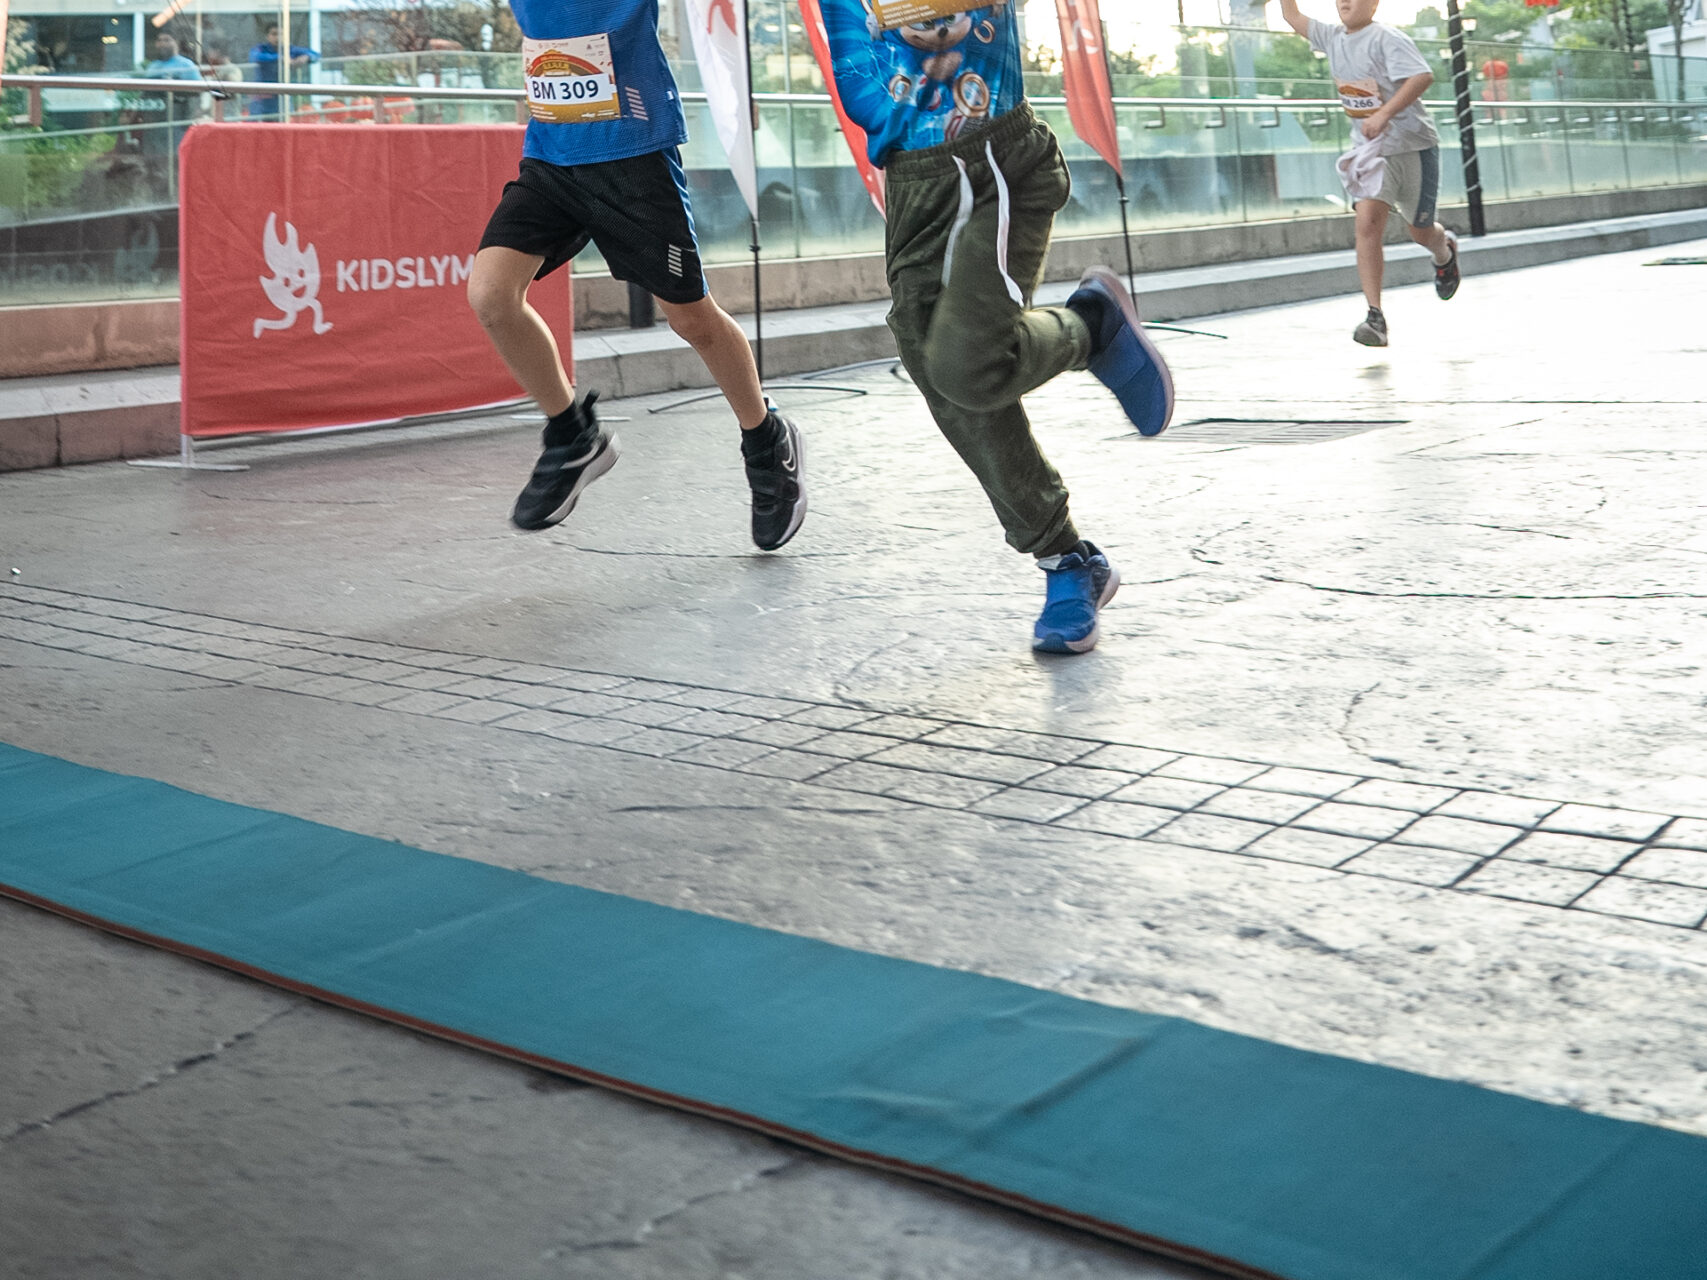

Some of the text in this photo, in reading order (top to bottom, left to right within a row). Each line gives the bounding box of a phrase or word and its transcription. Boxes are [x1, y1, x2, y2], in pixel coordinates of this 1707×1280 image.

[532, 79, 598, 99] BM 309
[1353, 99, 1373, 108] 266
[336, 253, 475, 293] KIDSLYM
